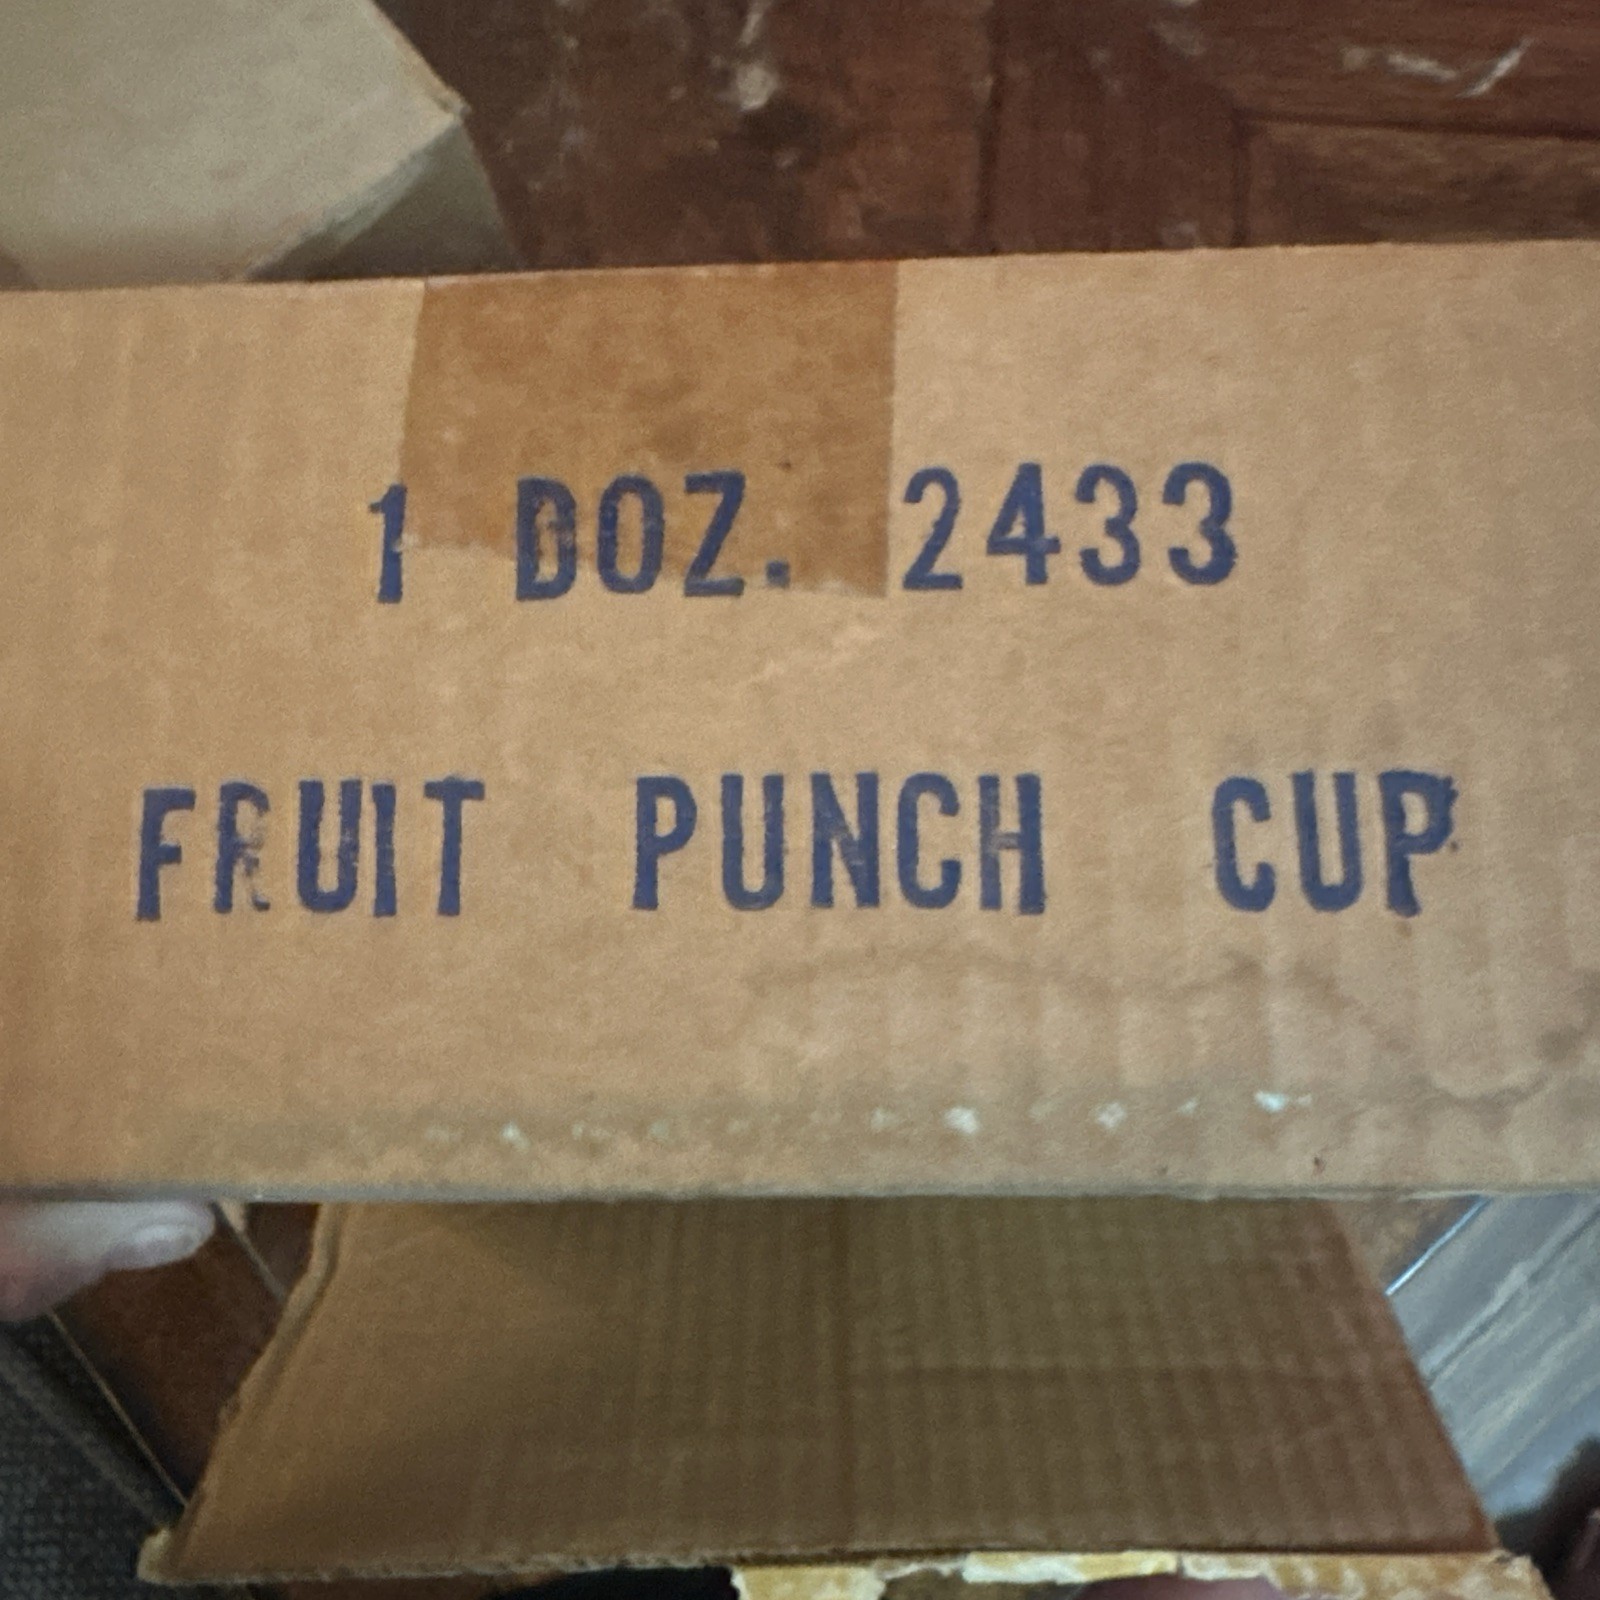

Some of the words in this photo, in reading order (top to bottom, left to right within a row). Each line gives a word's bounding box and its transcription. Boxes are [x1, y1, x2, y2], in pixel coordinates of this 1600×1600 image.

[369, 484, 408, 603] 1
[515, 470, 792, 600] DOZ.
[902, 461, 1238, 590] 2433
[136, 775, 485, 922] FRUIT
[632, 770, 1047, 915] PUNCH
[1210, 768, 1459, 917] CUP
